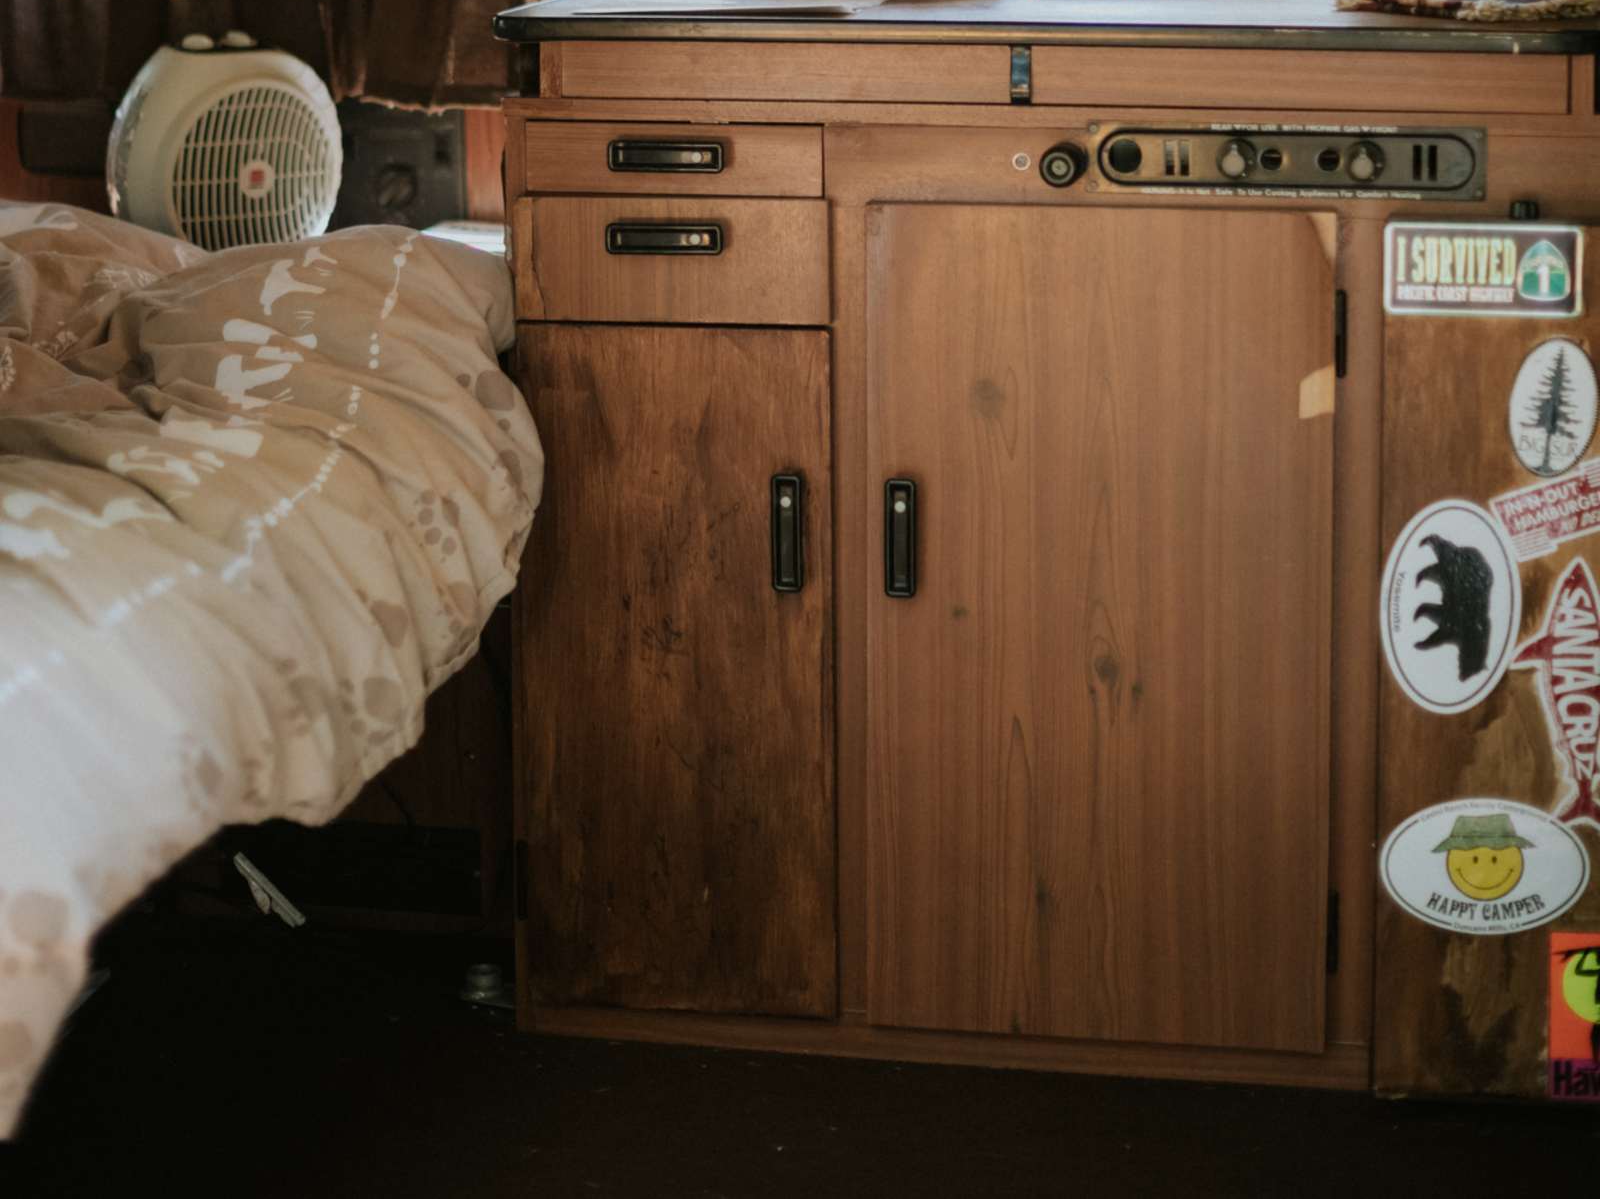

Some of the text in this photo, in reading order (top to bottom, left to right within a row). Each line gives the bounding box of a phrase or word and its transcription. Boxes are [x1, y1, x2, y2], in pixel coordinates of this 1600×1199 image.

[1215, 188, 1233, 196] Safe
[1247, 188, 1263, 196] Use
[1265, 189, 1297, 197] Cooking
[1340, 190, 1354, 198] For
[1396, 235, 1517, 286] I SURVIVED
[1536, 265, 1551, 294] 1
[1519, 434, 1579, 457] BIG SUR
[1503, 481, 1579, 516] IN-N-OUT
[1514, 490, 1600, 531] HAMBURGE
[1551, 585, 1600, 780] SANTA CRUZ
[1426, 892, 1546, 921] HAPPY CAMPER
